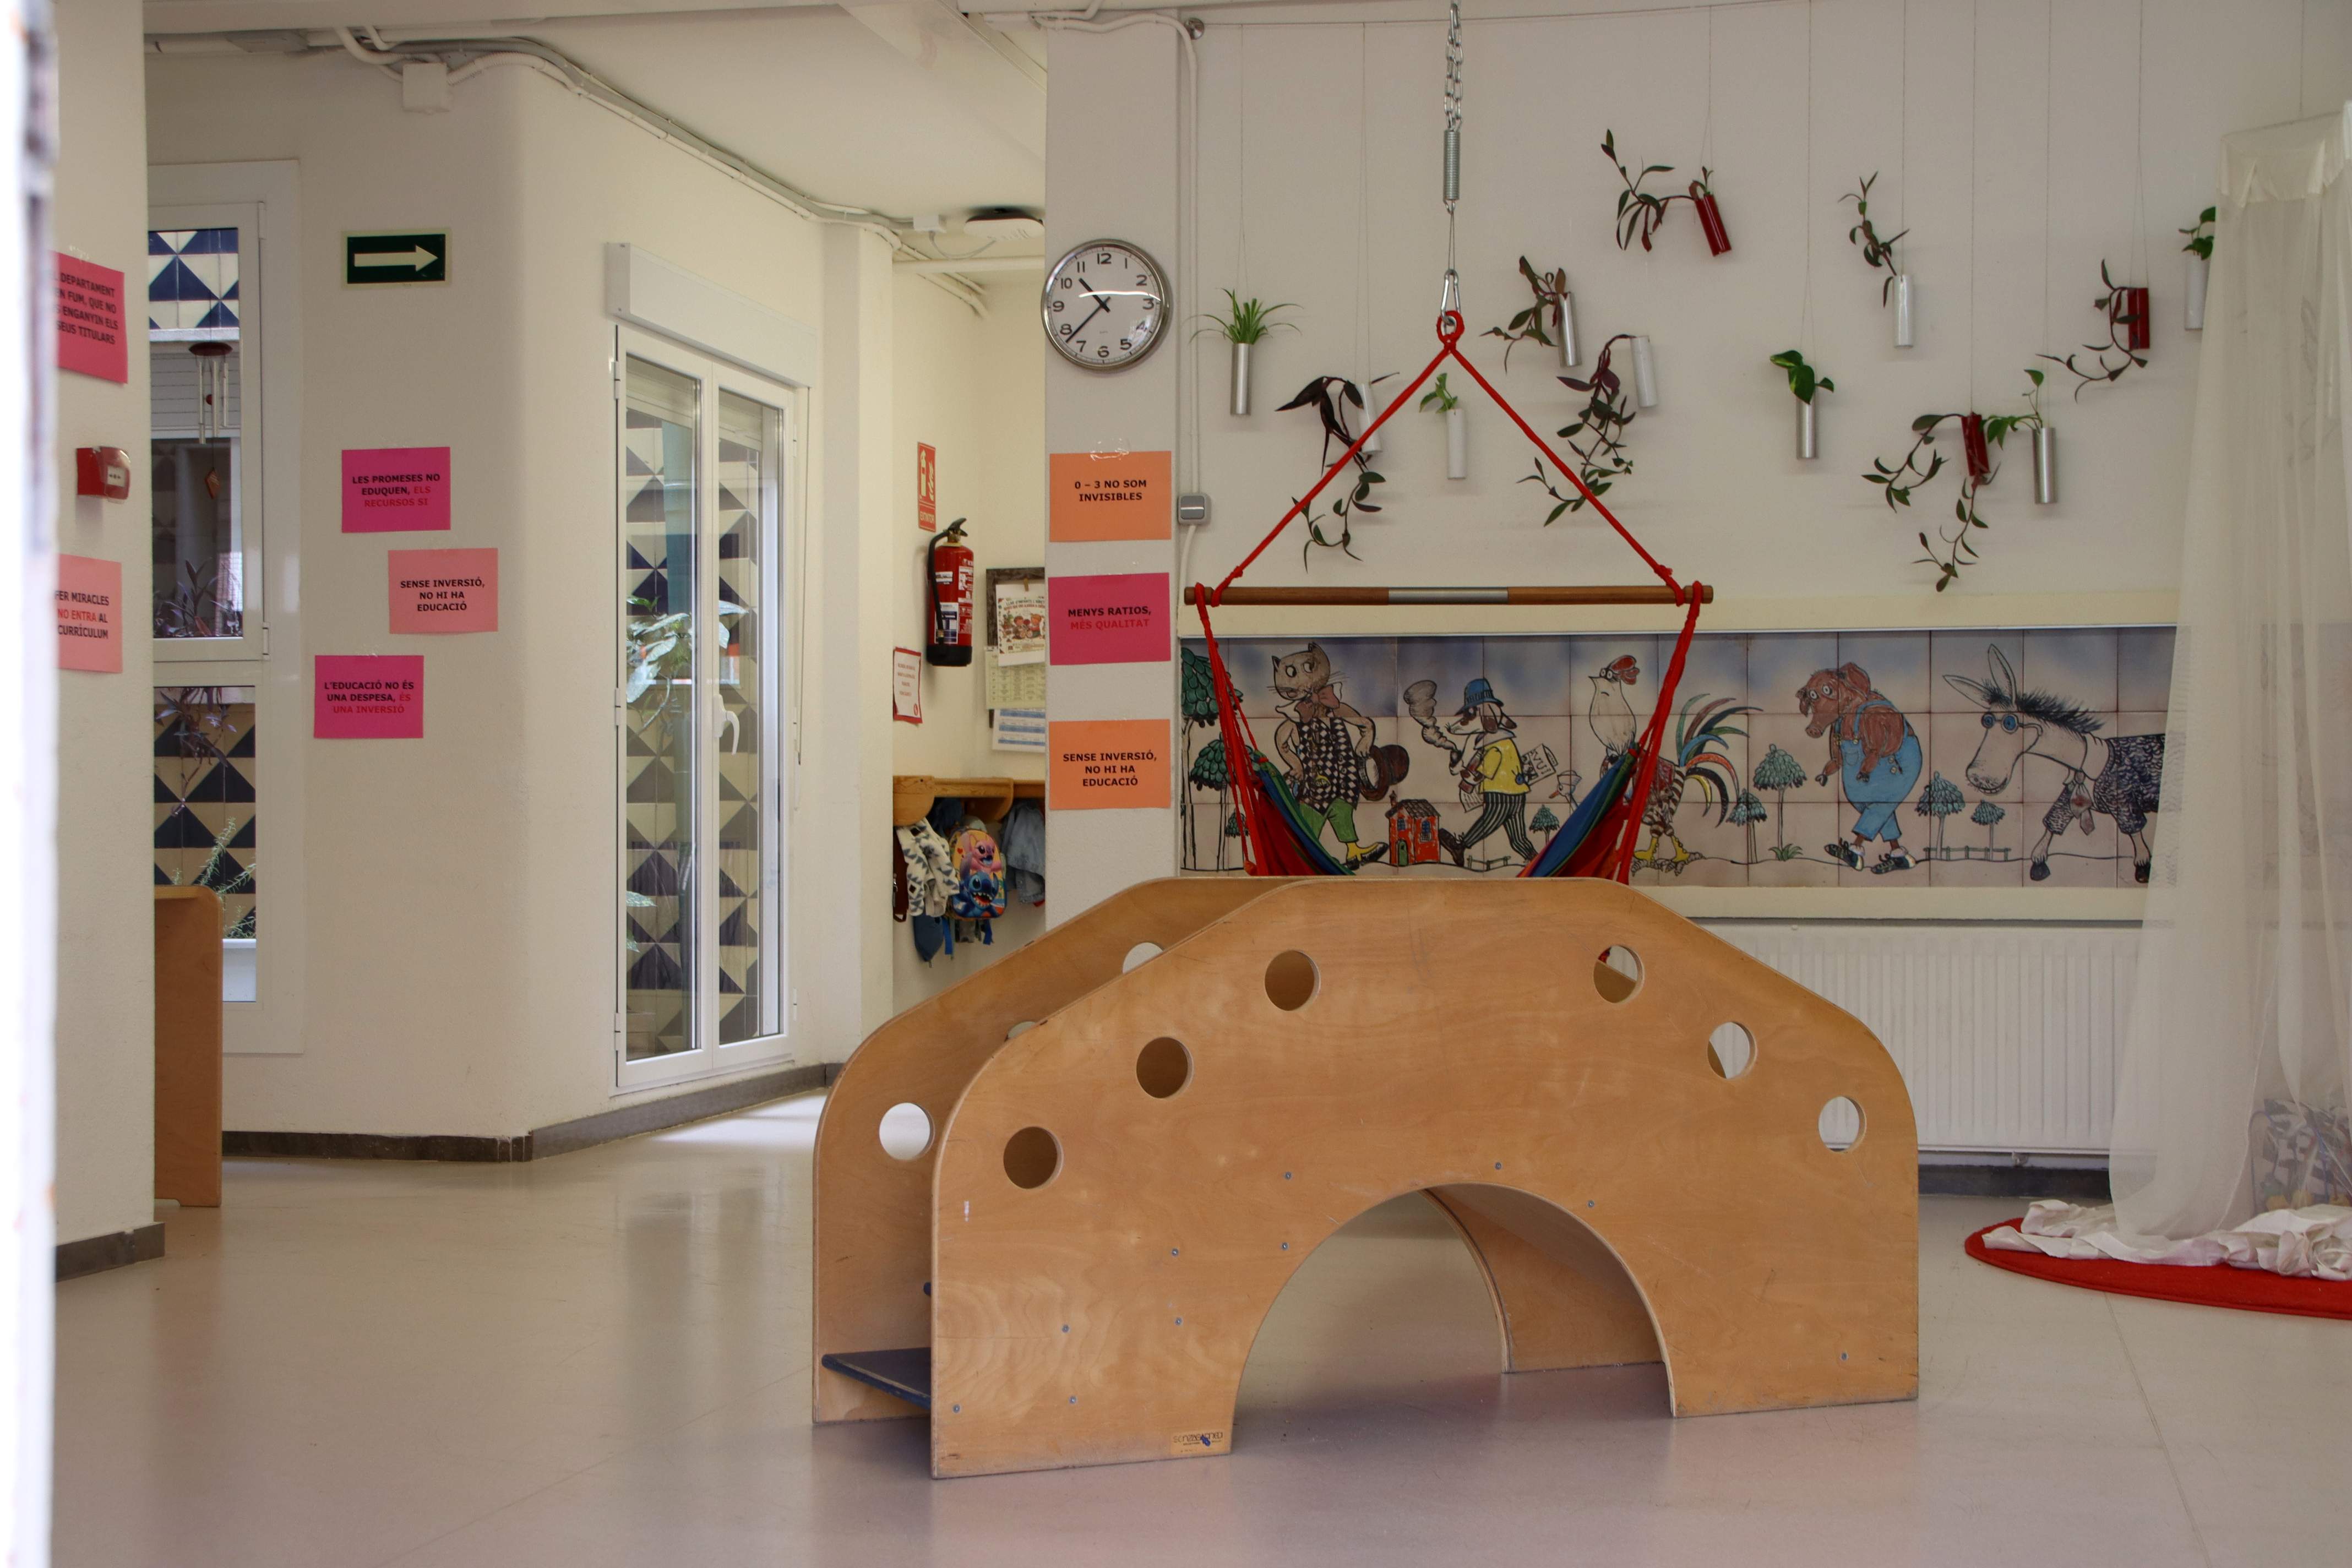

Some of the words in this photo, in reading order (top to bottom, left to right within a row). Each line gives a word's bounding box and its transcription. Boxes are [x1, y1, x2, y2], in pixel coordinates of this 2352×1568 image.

[1097, 253, 1112, 264] 12
[1125, 258, 1128, 269] 1
[1077, 262, 1085, 273] 11
[60, 273, 115, 297] DEPARTAMENT
[1060, 278, 1072, 289] 10
[1136, 275, 1147, 286] 2
[89, 297, 104, 310] QUE
[106, 303, 117, 314] NO
[1053, 301, 1064, 312] 9
[1142, 298, 1154, 310] 3
[62, 306, 104, 325] ENGANYIN
[106, 318, 118, 330] ELS
[1060, 324, 1072, 335] 8
[1136, 320, 1147, 332] 4
[57, 320, 77, 334] SEUS
[78, 326, 115, 345] TITULARS
[1076, 341, 1086, 352] 7
[1120, 339, 1132, 350] 5
[1098, 346, 1109, 357] 6
[372, 475, 423, 483] PROMESES
[1104, 480, 1120, 488] NO
[1123, 480, 1147, 488] SOM
[362, 487, 410, 496] EDUQUEN,
[1079, 492, 1142, 502] INVISIBLES
[364, 498, 415, 507] RECURSOS
[433, 576, 484, 588] INVERSIÓ,
[55, 590, 69, 601] FER
[72, 592, 109, 606] MIRACLES
[417, 601, 467, 612] EDUCACIÓ
[1068, 608, 1104, 617] MENYS
[1108, 606, 1151, 616] RATIOS,
[58, 609, 69, 619] NO
[72, 610, 97, 622] ENTRA
[99, 613, 108, 623] AL
[1071, 619, 1092, 630] MÉS
[1096, 619, 1150, 630] QUALITAT
[58, 623, 108, 639] CURRÍCULUM
[324, 680, 382, 689] L'EDUCACIÓ
[402, 679, 414, 689] ÉS
[350, 694, 396, 703] DESPESA,
[400, 692, 411, 701] ÉS
[356, 704, 405, 713] INVERSIÓ
[1063, 753, 1097, 762] SENSE
[1100, 749, 1157, 761] INVERSIÓ,
[1104, 765, 1117, 774] HI
[1082, 776, 1138, 787] EDUCACIÓ
